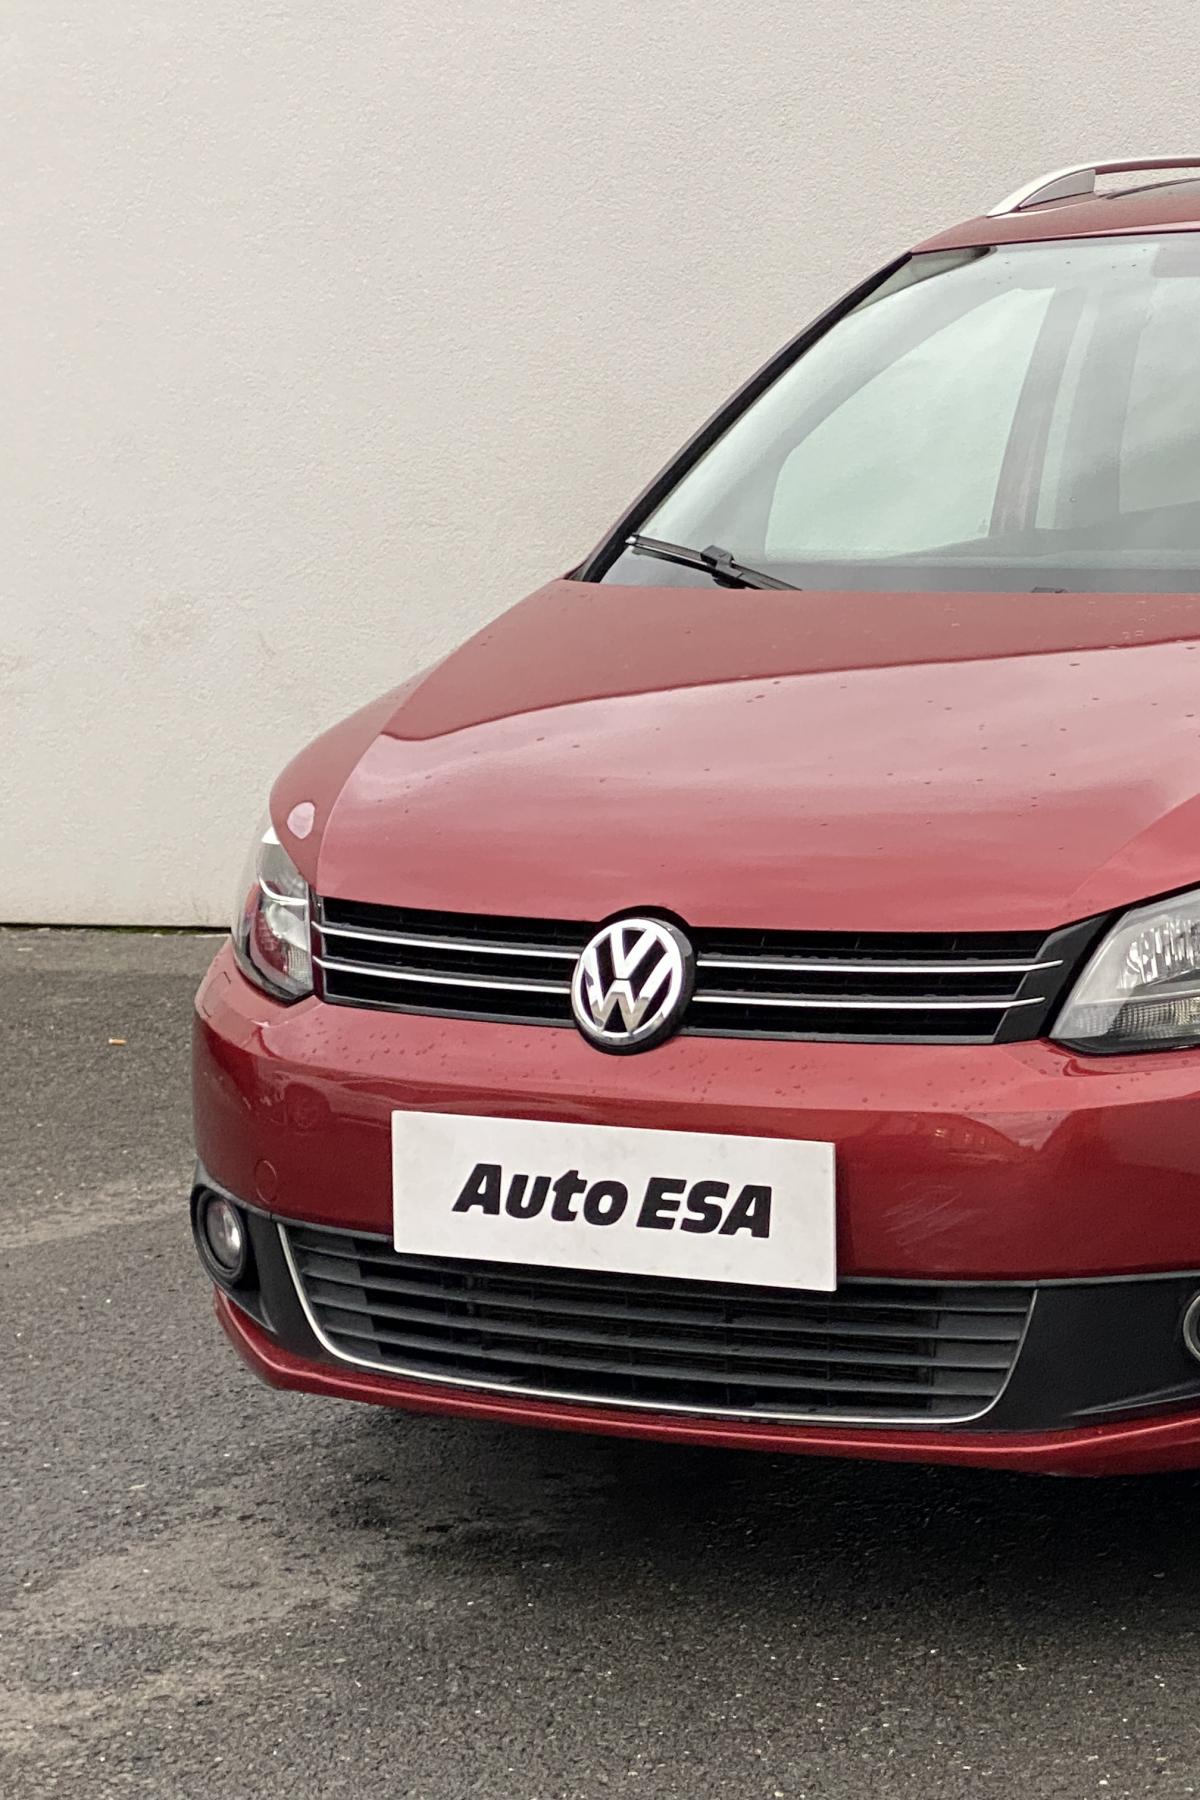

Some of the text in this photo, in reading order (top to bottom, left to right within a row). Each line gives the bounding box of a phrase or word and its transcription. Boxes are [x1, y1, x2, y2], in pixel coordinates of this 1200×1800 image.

[575, 921, 681, 1037] VW
[452, 1163, 772, 1239] Auto ESA
